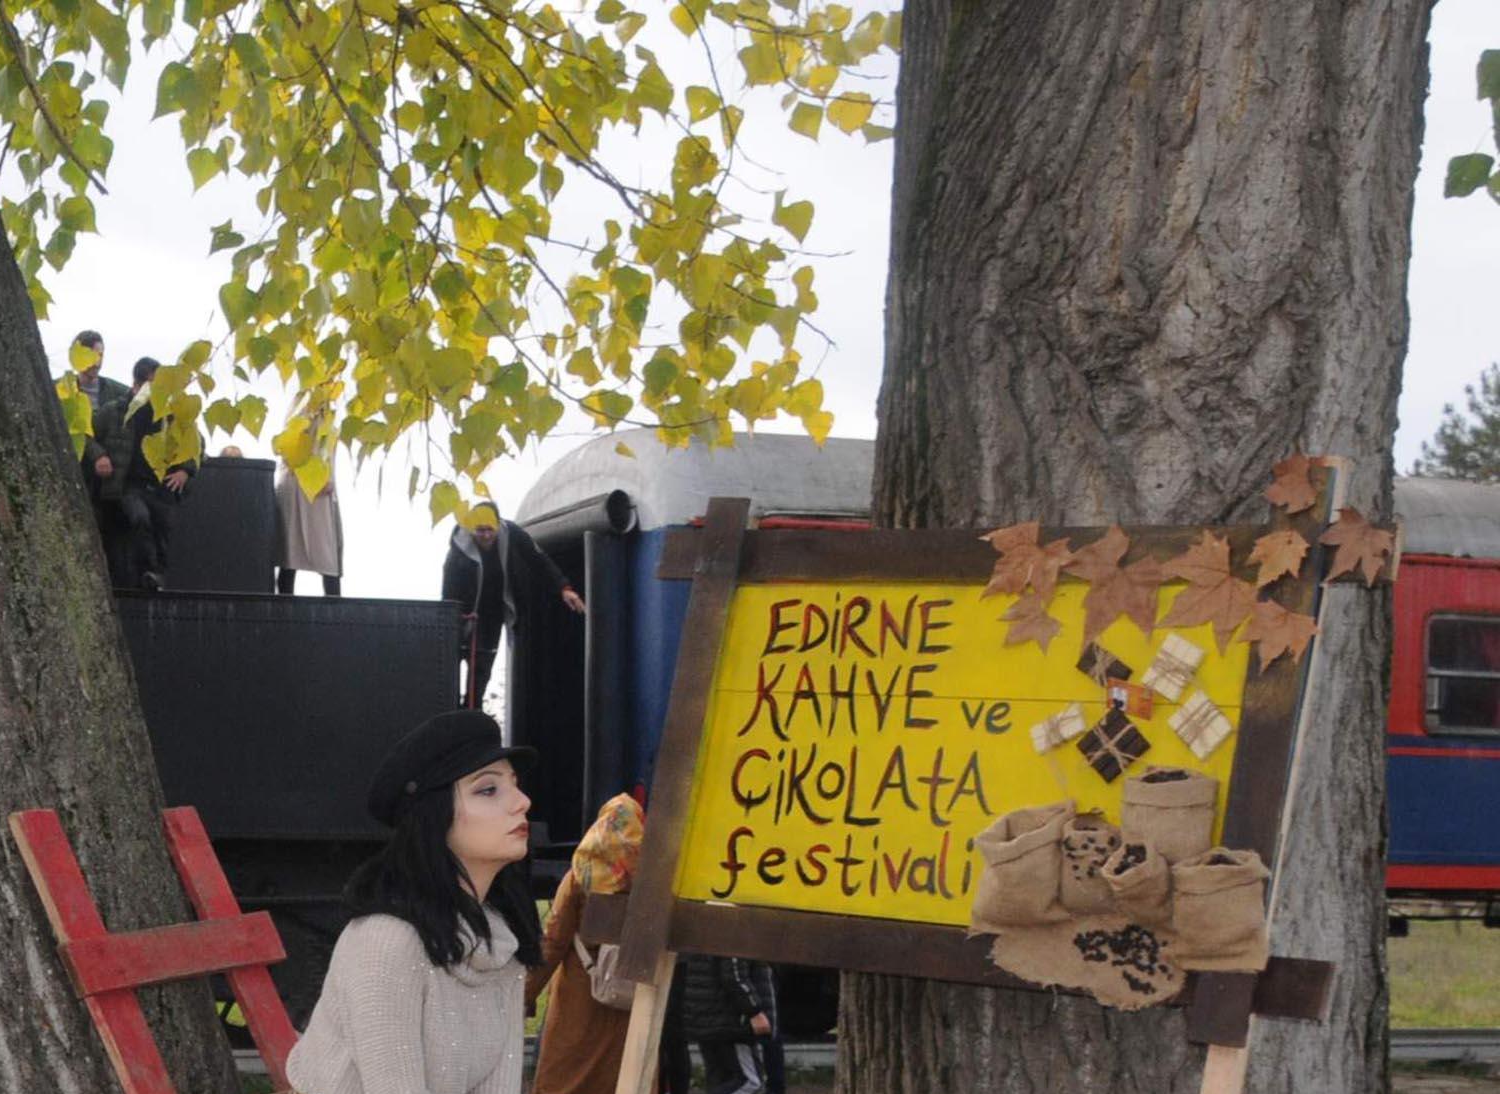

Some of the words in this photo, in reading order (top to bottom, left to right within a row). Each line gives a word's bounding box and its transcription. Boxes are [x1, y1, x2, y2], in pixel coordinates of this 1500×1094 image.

[737, 662, 939, 741] KAHVE
[961, 700, 1012, 734] ve
[711, 827, 975, 899] festivali
